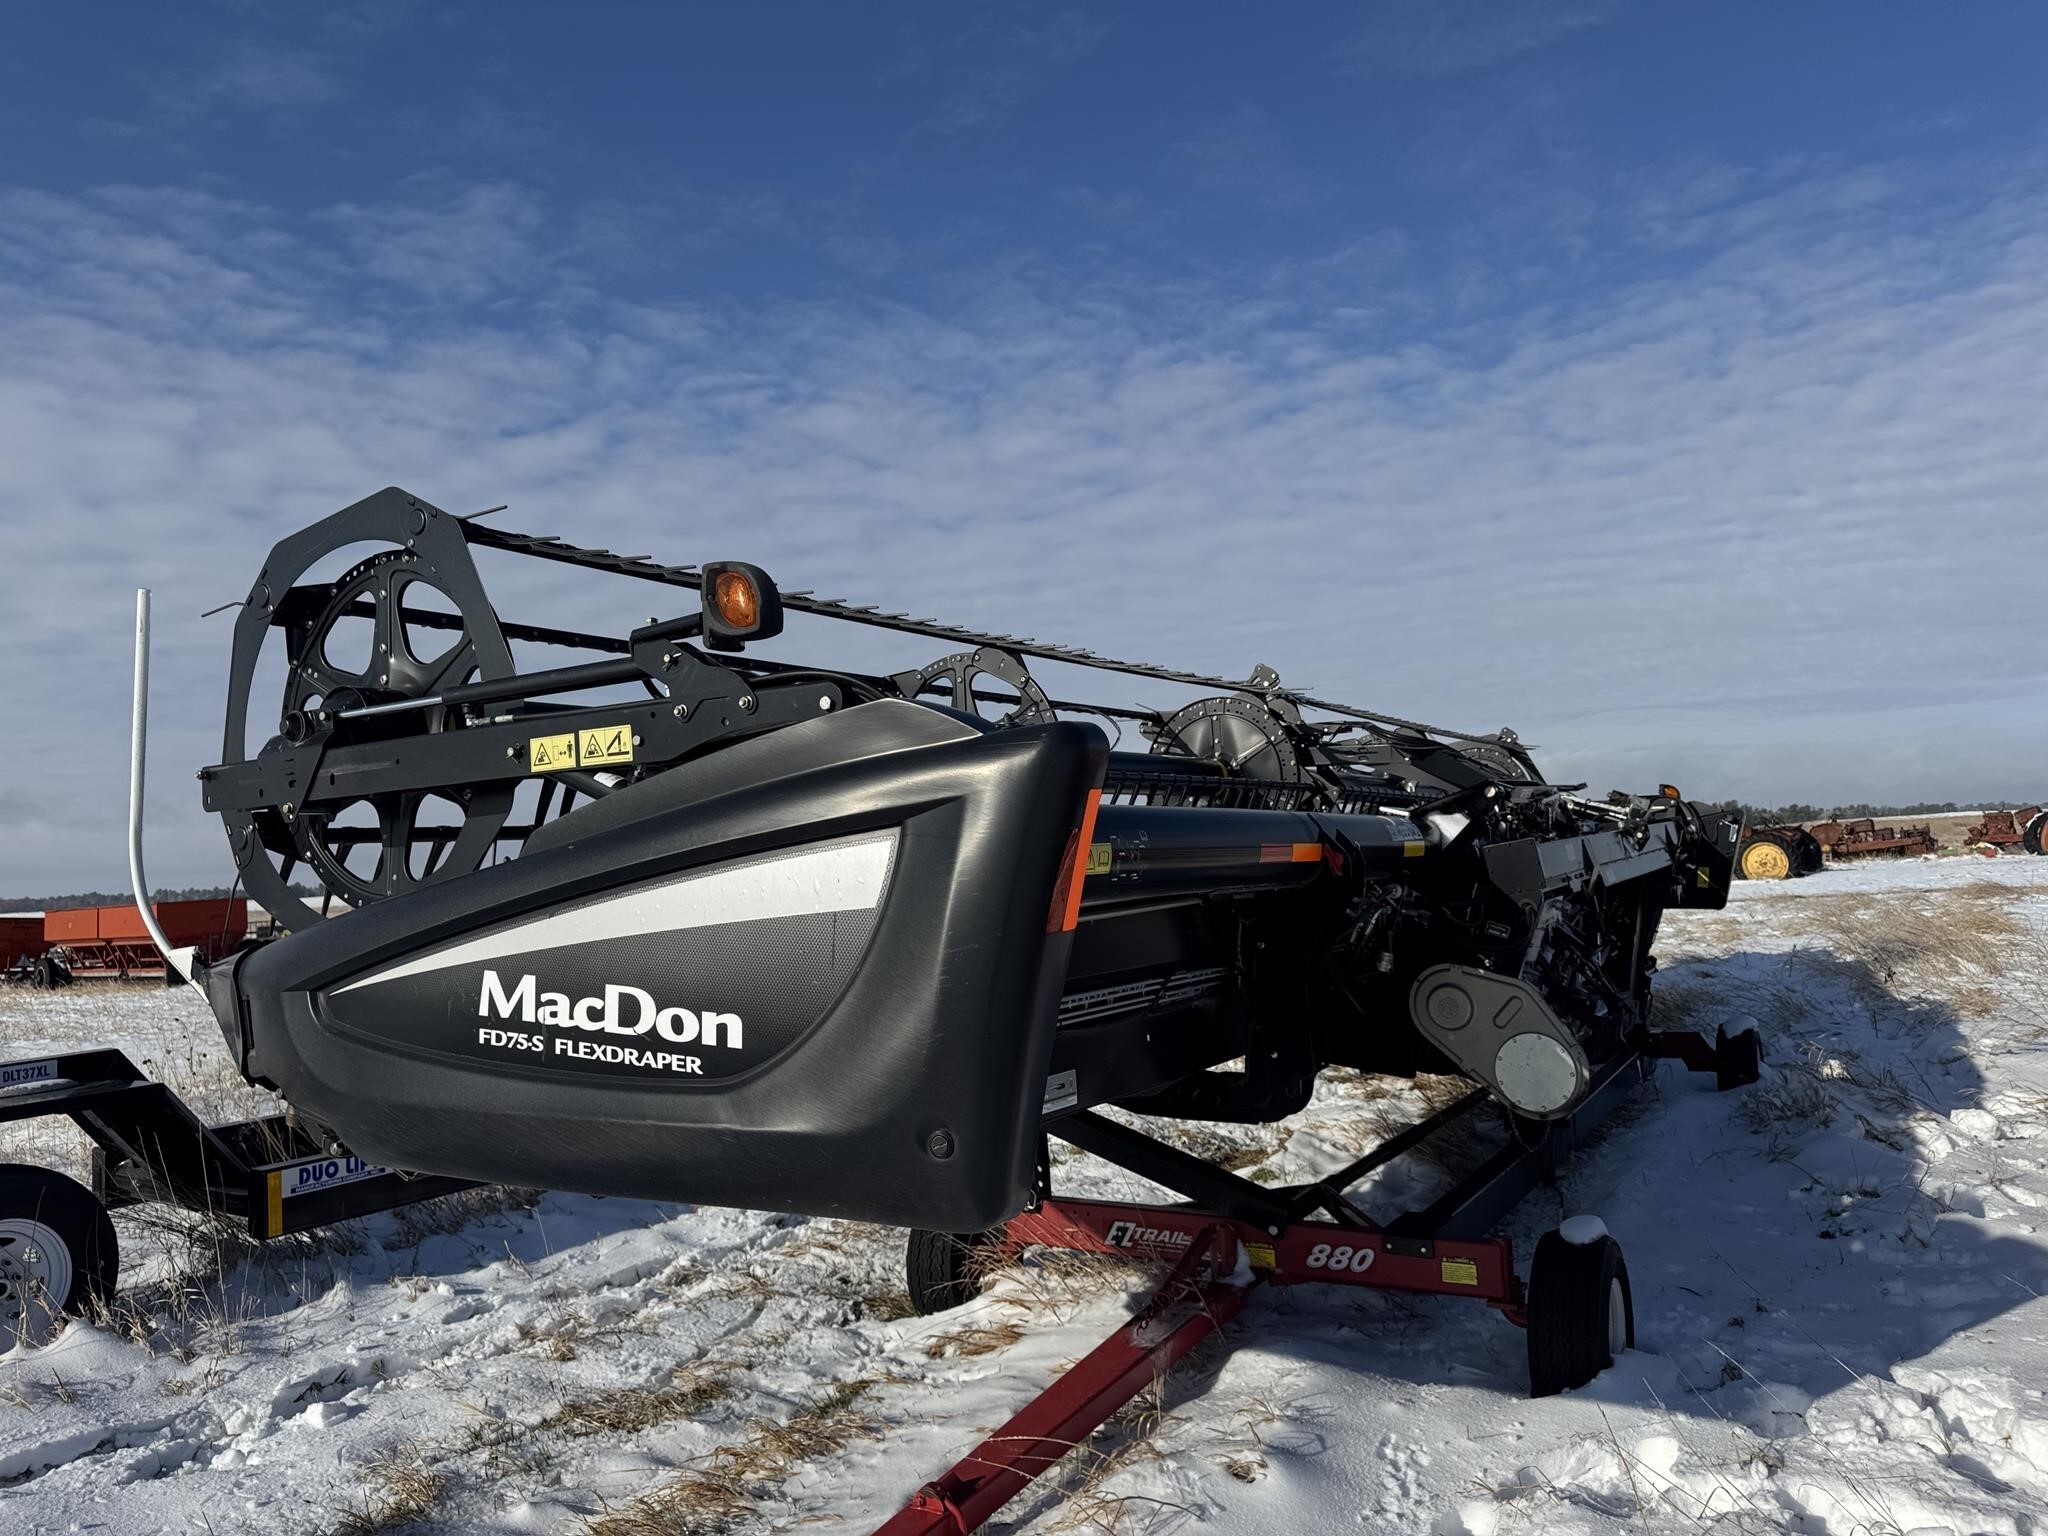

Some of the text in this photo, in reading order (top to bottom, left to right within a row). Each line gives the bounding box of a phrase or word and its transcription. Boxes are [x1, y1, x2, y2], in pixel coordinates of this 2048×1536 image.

[478, 970, 743, 1049] MacDon
[478, 1028, 704, 1075] FD75-S FLEXDRAPER
[2, 1065, 50, 1083] DLT37XL
[298, 1161, 339, 1185] DUO
[1306, 1243, 1375, 1273] 880
